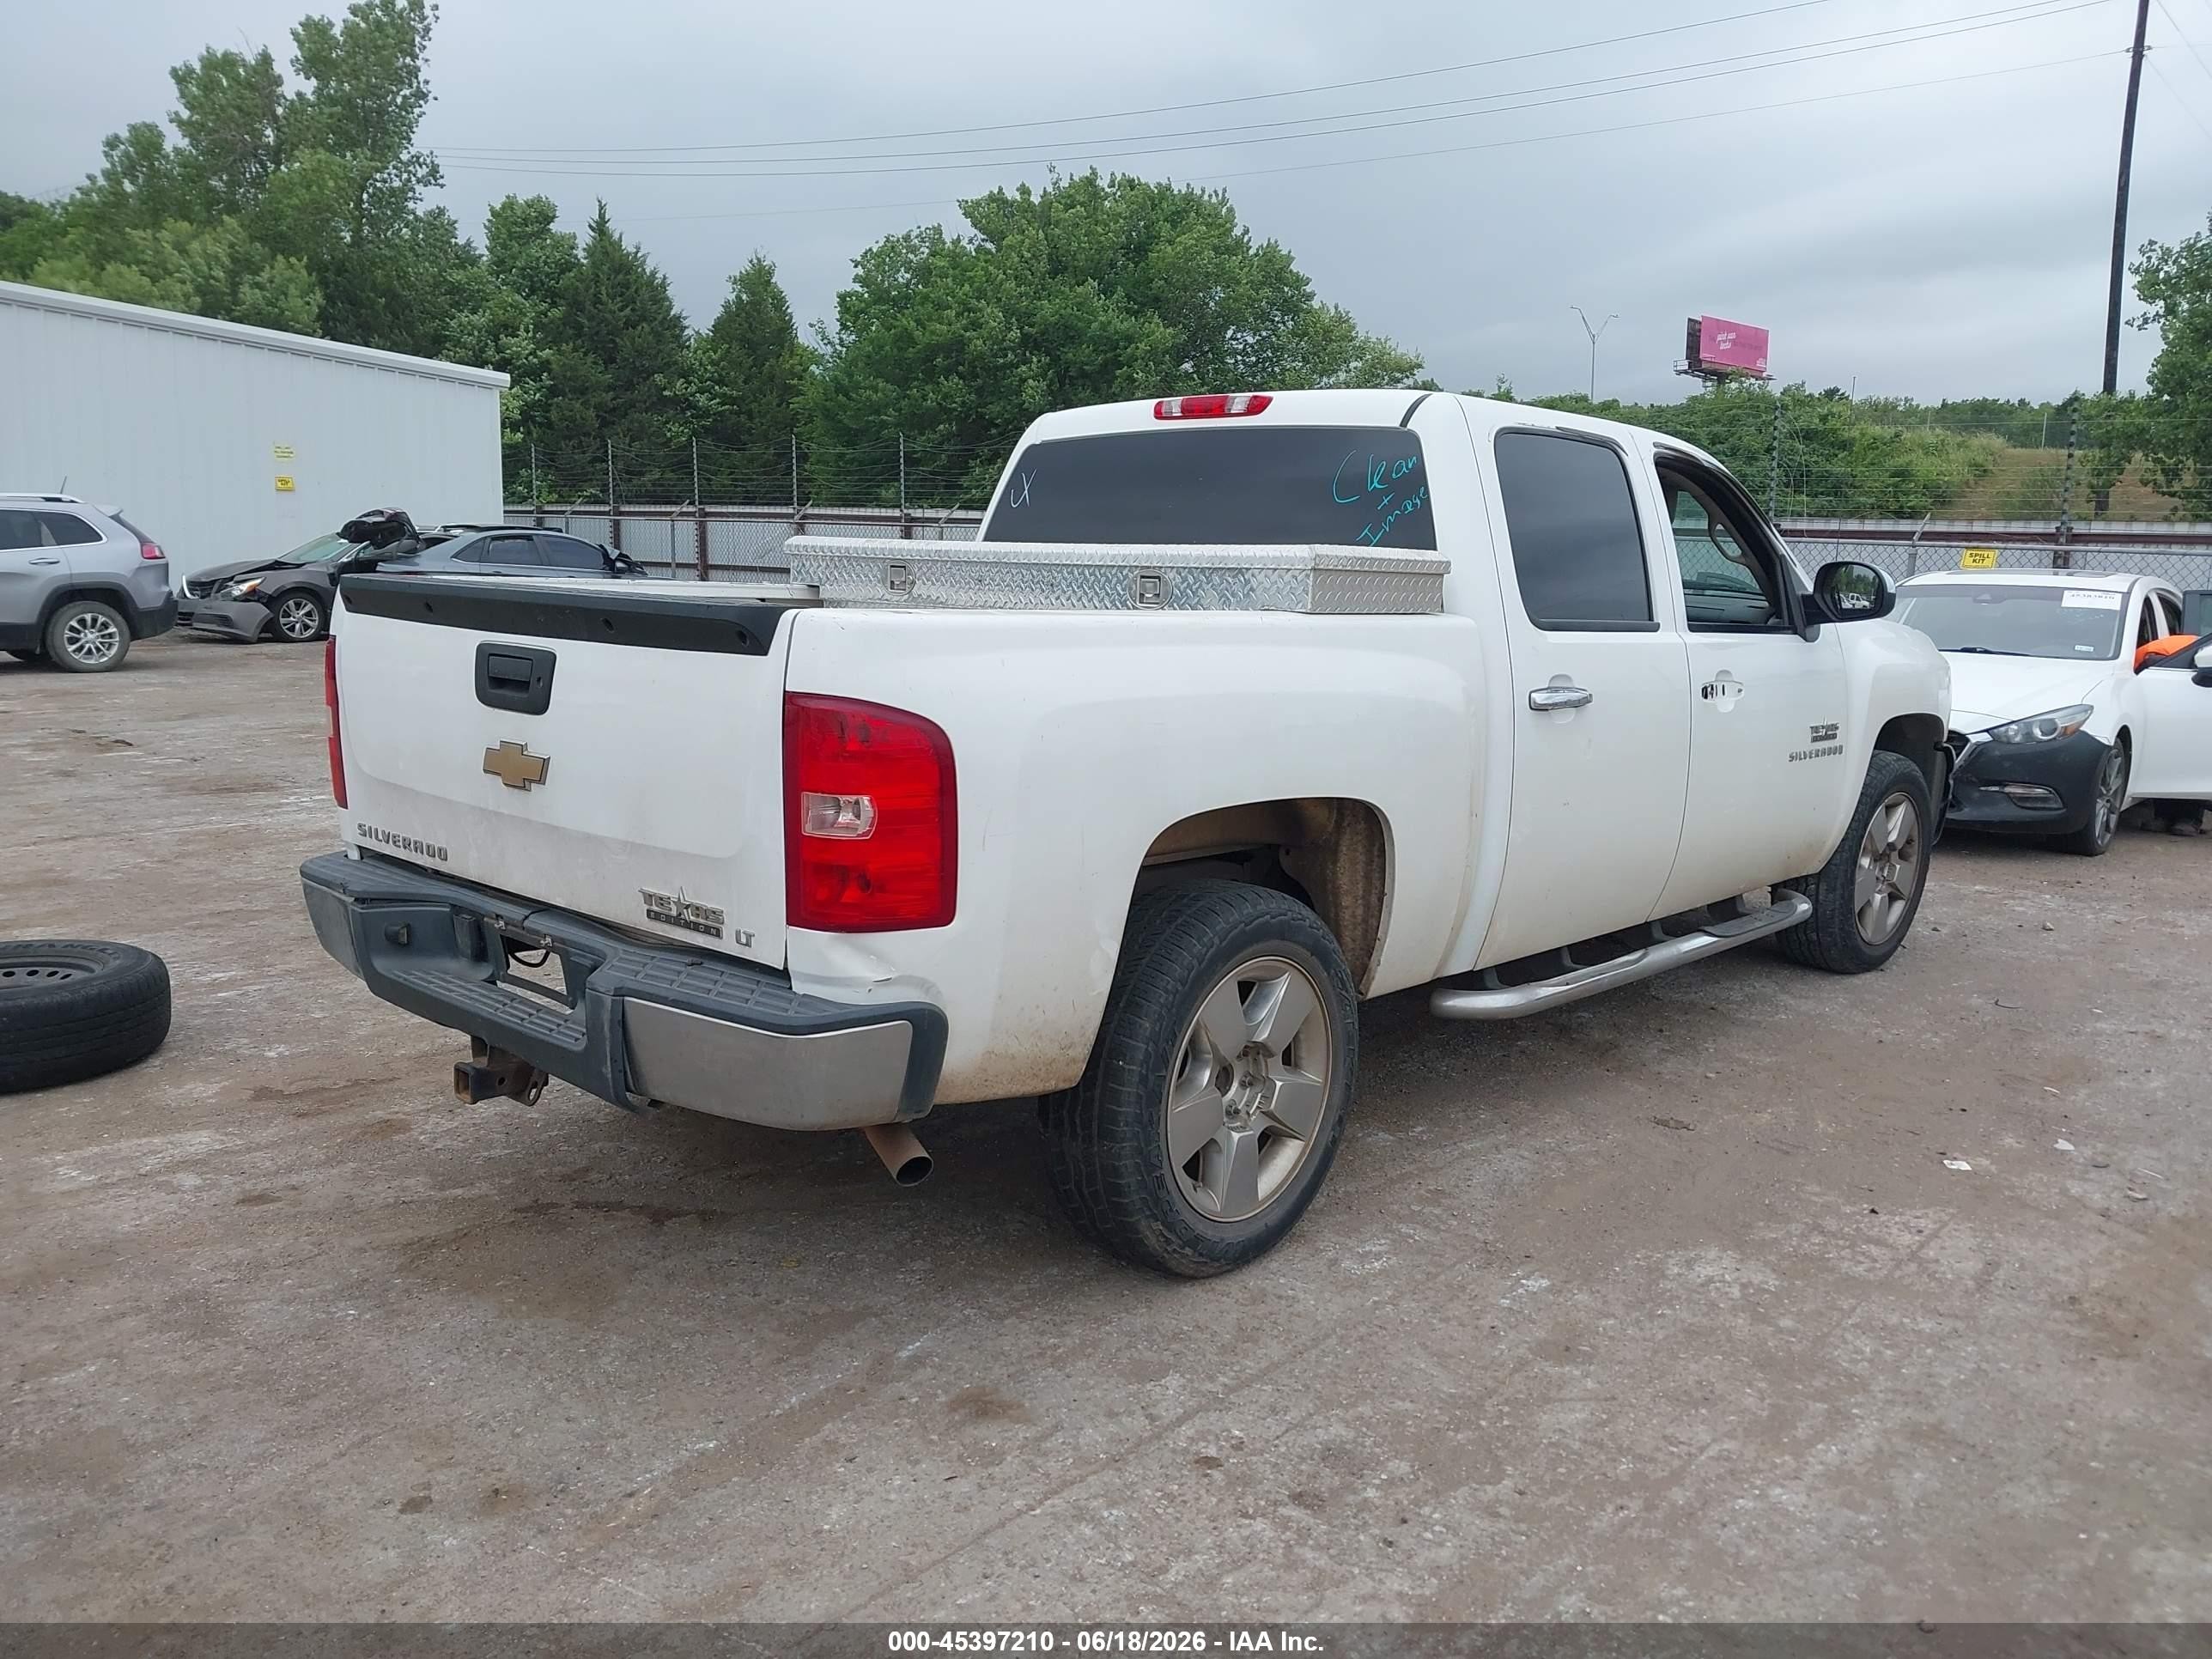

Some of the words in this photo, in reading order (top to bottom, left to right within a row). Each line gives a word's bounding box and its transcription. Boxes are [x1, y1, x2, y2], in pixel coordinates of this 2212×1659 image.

[1333, 449, 1418, 503] Clean
[356, 822, 448, 862] SILVERADO
[649, 910, 718, 936] EDITION
[735, 927, 756, 948] LT
